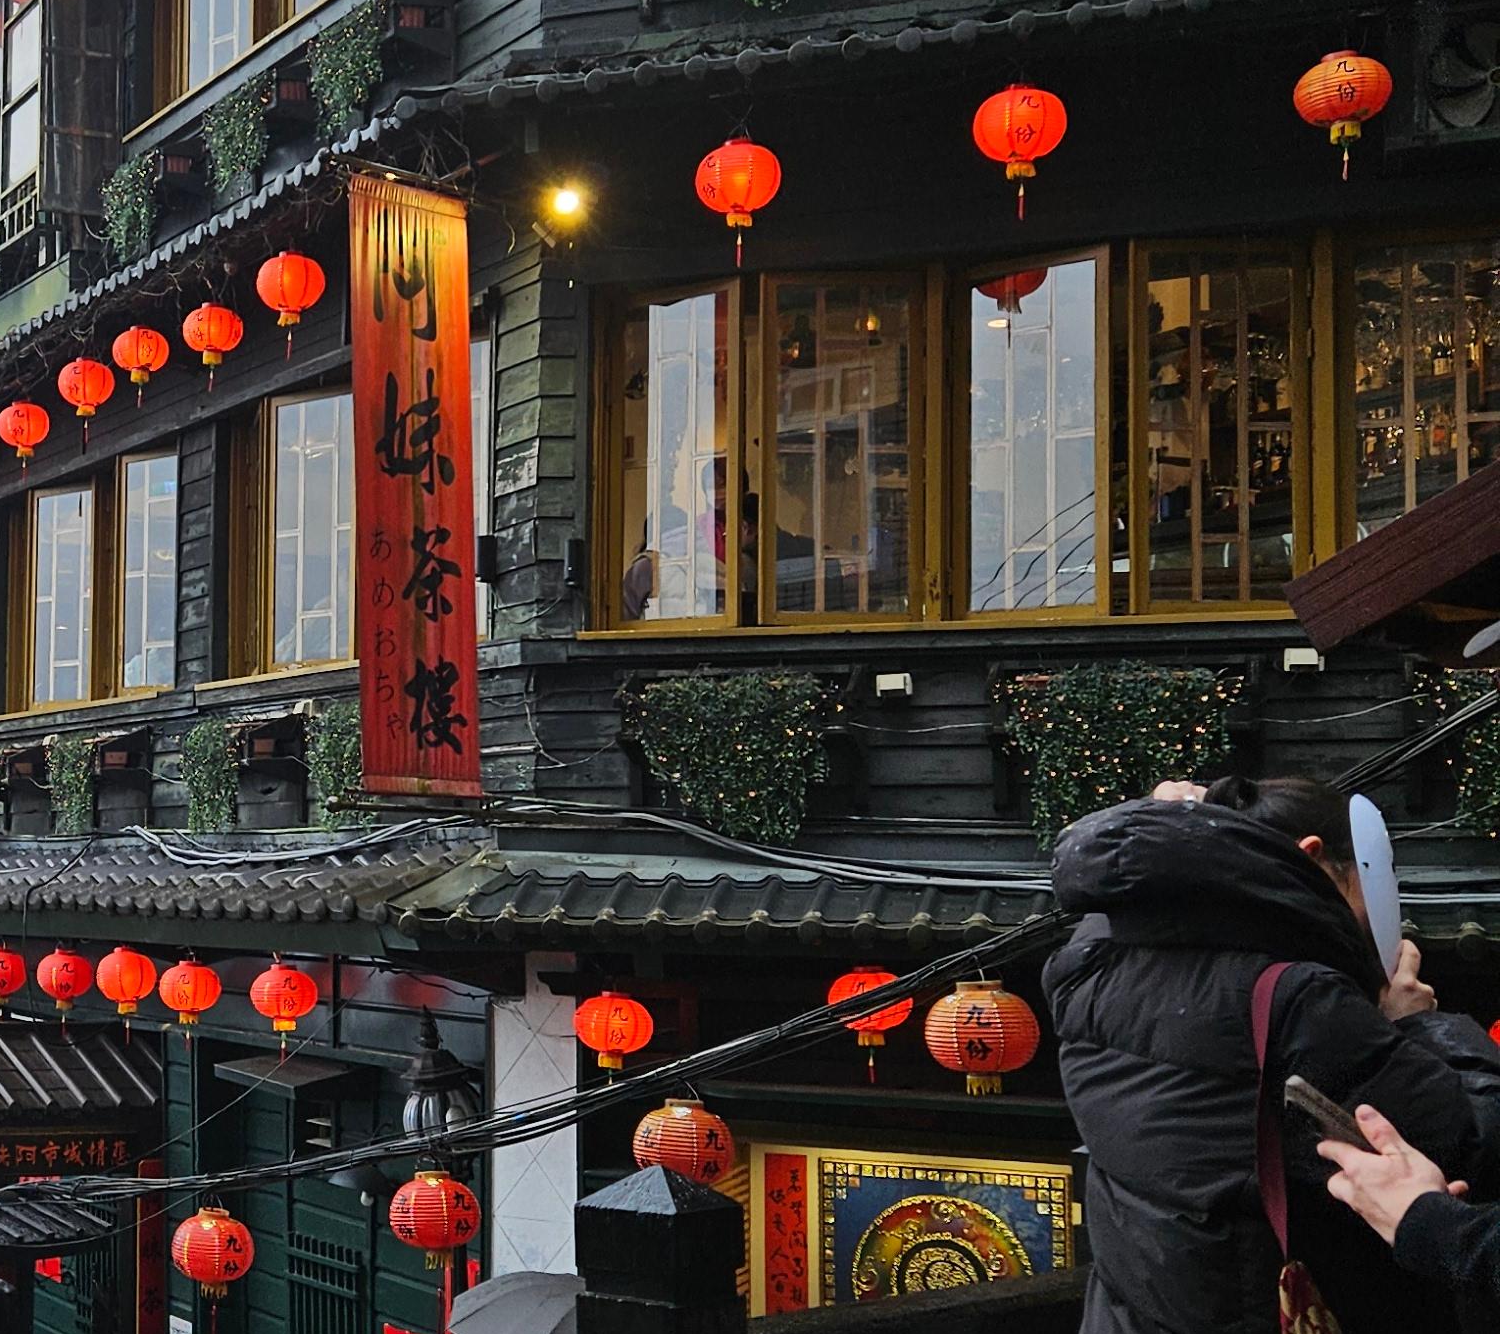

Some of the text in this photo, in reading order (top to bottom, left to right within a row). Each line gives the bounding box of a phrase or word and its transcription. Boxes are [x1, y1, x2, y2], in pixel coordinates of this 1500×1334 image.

[1335, 59, 1356, 103] 九份
[1015, 95, 1041, 144] 九份
[369, 525, 405, 742] あめおちゃ
[282, 976, 298, 1011] 九份
[609, 1004, 629, 1047] 九份
[963, 1005, 993, 1061] 九份
[702, 1128, 725, 1179] 九份
[453, 1191, 472, 1236] 九份
[223, 1233, 243, 1277] 九份
